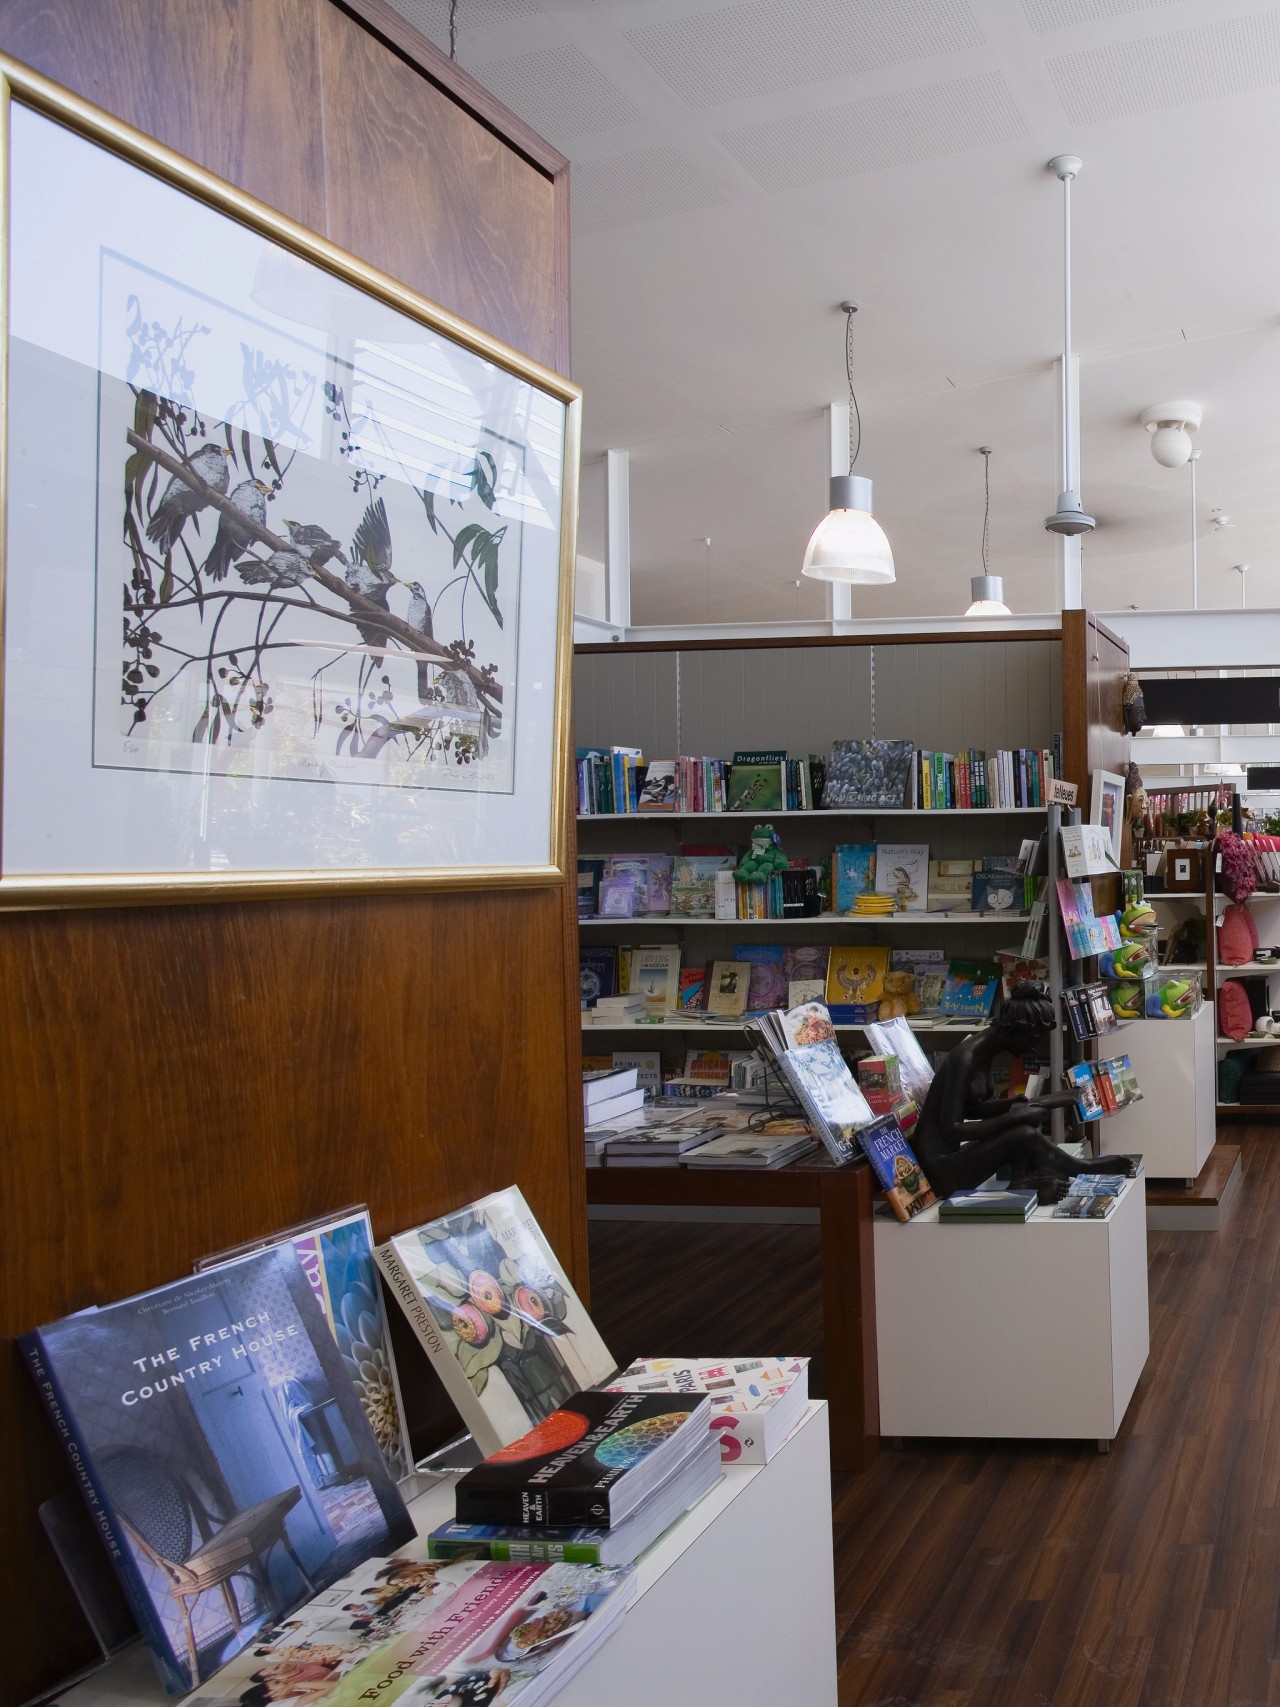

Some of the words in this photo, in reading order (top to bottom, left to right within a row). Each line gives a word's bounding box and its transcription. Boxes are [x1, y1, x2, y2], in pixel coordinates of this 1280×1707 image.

[737, 754, 784, 763] Dragonflies
[1054, 785, 1074, 802] teNeues
[691, 1060, 729, 1070] ORIGAMI
[874, 1128, 904, 1150] FRENCH
[880, 1138, 908, 1161] MARKET
[138, 1297, 172, 1316] Christiane
[380, 1248, 417, 1307] MARGARET
[411, 1305, 444, 1354] PRESTON
[133, 1347, 181, 1374] THE
[189, 1311, 271, 1352] FRENCH
[121, 1355, 223, 1407] COUNTRY
[231, 1324, 299, 1361] HOUSE
[672, 1368, 697, 1393] PARIS
[29, 1347, 45, 1378] THE
[42, 1381, 70, 1440] FRENCH
[68, 1442, 101, 1507] COUNTRY
[95, 1509, 122, 1559] HOUSE
[522, 1491, 530, 1524] HEAVEN
[535, 1494, 543, 1522] EARTH
[359, 1659, 416, 1701] Food
[409, 1619, 456, 1660] with
[446, 1568, 514, 1625] Friends
[452, 1626, 483, 1655] CAMPION
[494, 1591, 521, 1619] MICHELE
